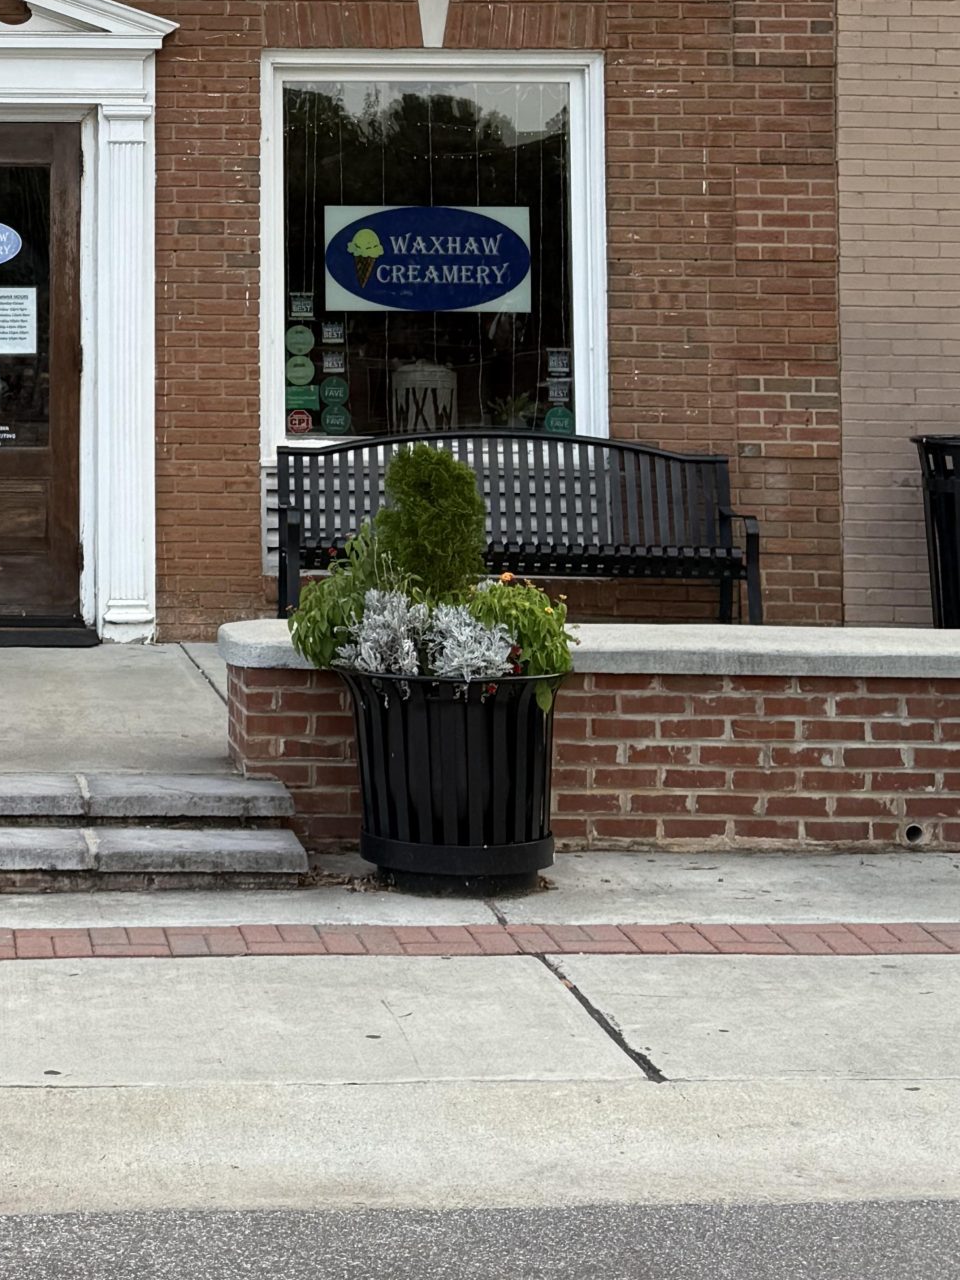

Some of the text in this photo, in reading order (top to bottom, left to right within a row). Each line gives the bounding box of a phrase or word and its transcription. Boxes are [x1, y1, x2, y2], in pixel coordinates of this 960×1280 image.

[390, 233, 503, 256] WAXHAW
[376, 262, 509, 285] CREAMERY
[290, 417, 310, 426] CPI
